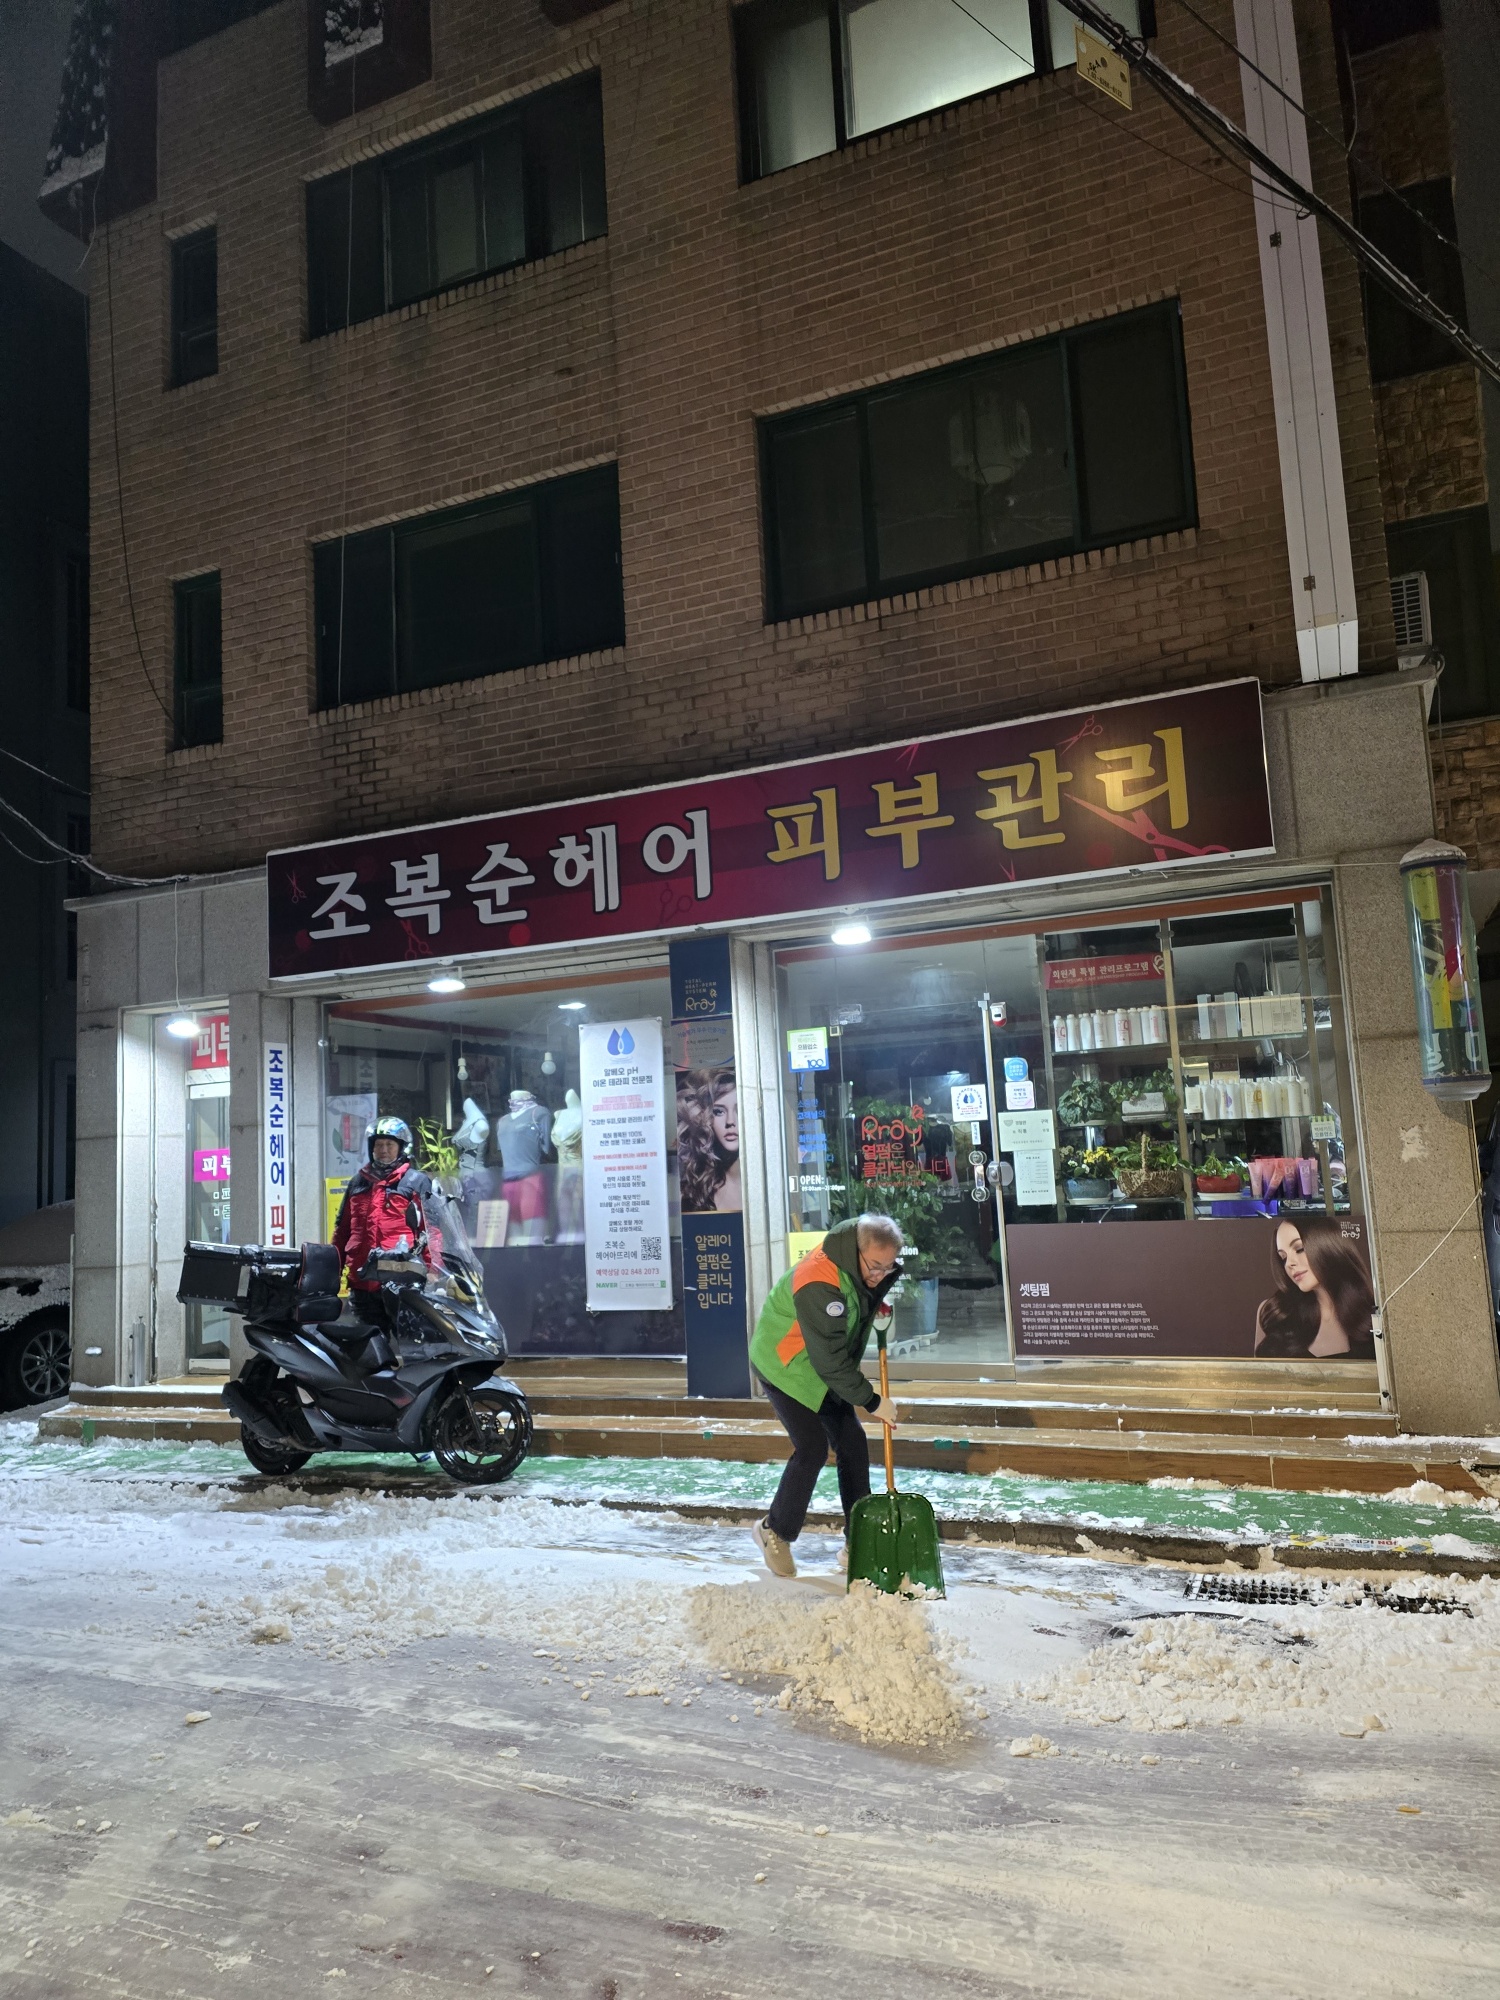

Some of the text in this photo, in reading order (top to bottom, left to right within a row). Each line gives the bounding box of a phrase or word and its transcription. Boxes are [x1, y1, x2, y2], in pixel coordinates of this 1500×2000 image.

[767, 727, 1190, 880] 피부관리
[1052, 962, 1149, 980] 회원제 특별 관리프로그램
[685, 997, 716, 1012] Rray
[627, 1066, 638, 1076] pH
[593, 1075, 653, 1088] 이온 테라피 전문점
[862, 1116, 923, 1147] Rray
[862, 1142, 905, 1160] 열펌은
[695, 1234, 732, 1250] 알레이
[1342, 1230, 1360, 1240] Rray
[605, 1240, 626, 1250] 조복순
[596, 1250, 638, 1260] 헤어아뜨리에
[696, 1253, 732, 1270] 열펌은
[596, 1268, 620, 1276] 예약상담
[697, 1272, 732, 1290] 클리닉
[1020, 1283, 1050, 1296] 셋팅펌
[698, 1292, 734, 1310] 입니다
